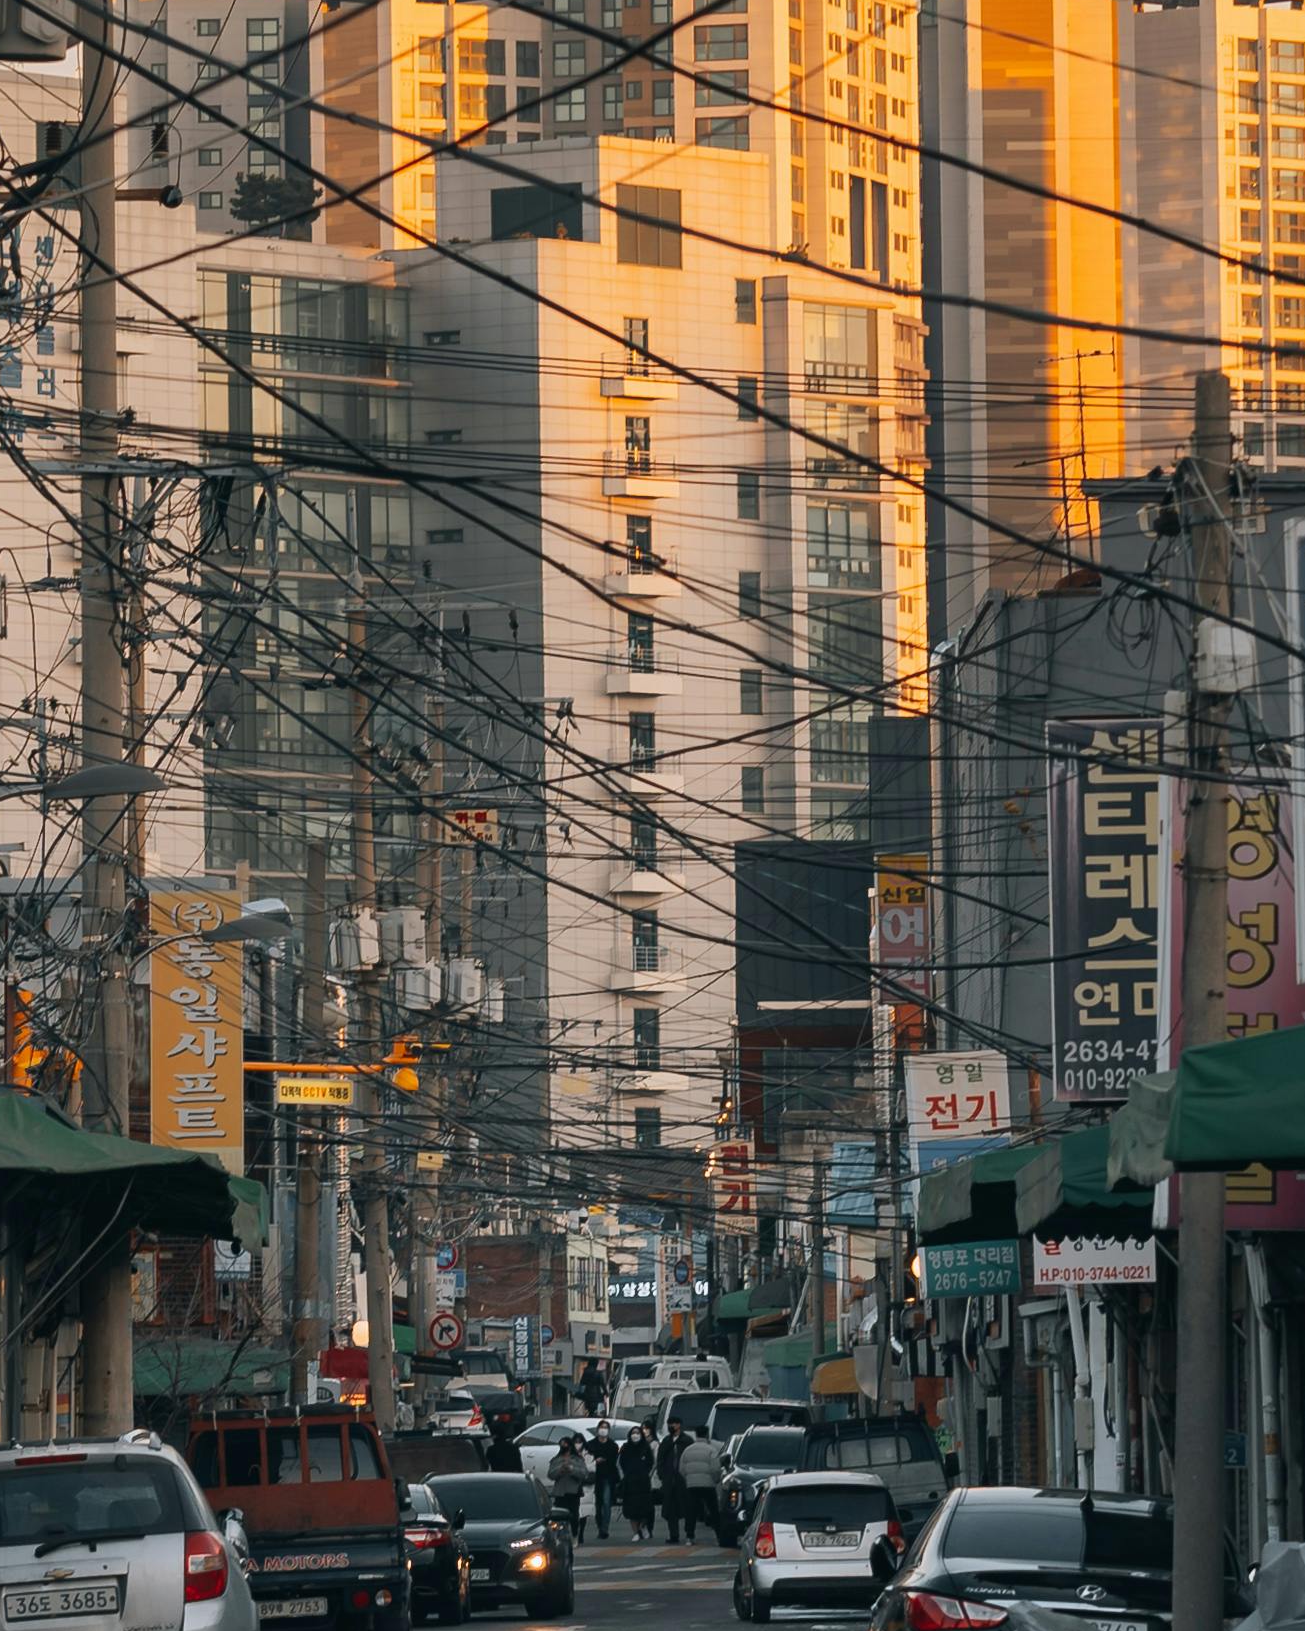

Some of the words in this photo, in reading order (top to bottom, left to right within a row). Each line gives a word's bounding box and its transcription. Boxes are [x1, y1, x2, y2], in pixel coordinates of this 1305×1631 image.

[936, 1062, 983, 1085] 영일
[303, 1086, 328, 1098] CCTV
[925, 1090, 998, 1130] 전기
[927, 1249, 969, 1269] 영등포
[973, 1246, 1015, 1266] 대리점
[934, 1270, 1012, 1292] 2676-5247
[263, 1552, 350, 1571] MOTORS
[60, 1590, 108, 1611] 3685
